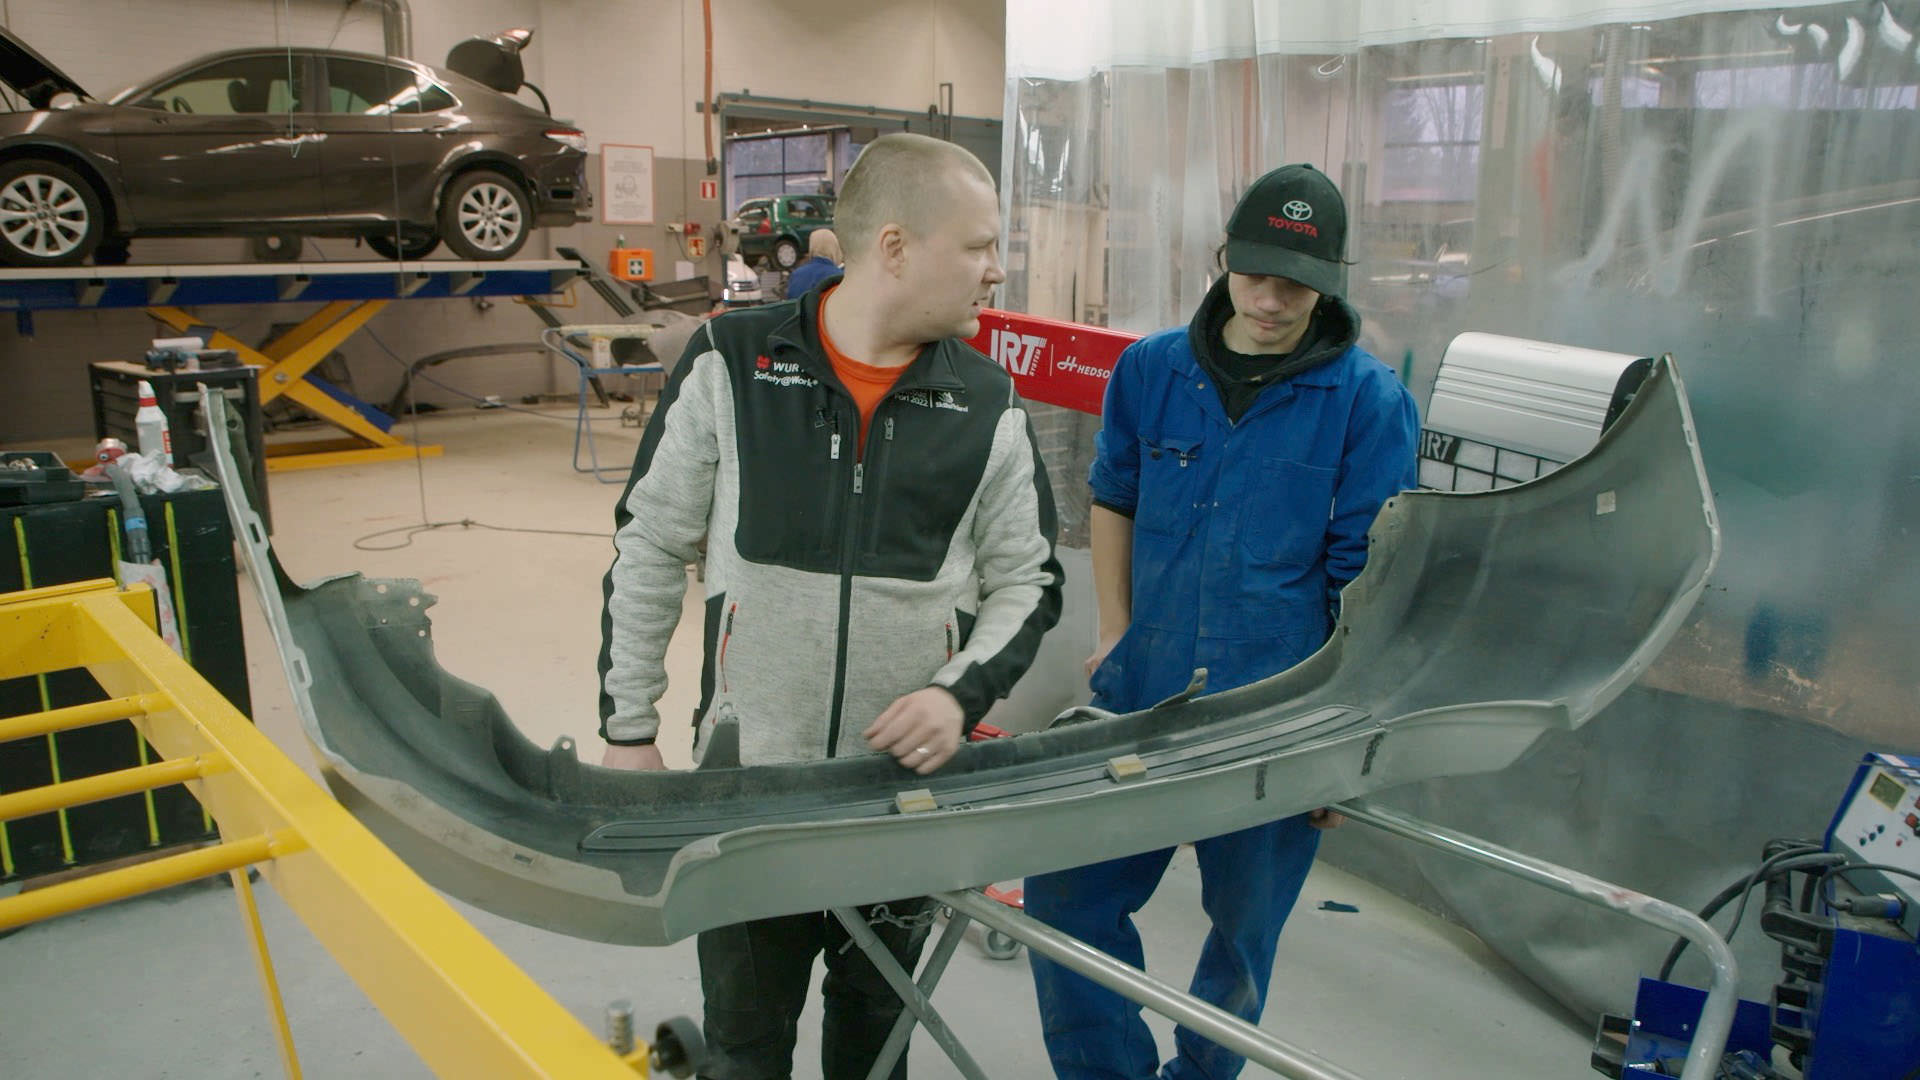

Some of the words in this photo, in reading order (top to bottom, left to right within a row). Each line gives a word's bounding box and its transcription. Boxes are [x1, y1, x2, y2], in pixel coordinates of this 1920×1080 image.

[1266, 215, 1319, 238] TOYOTA
[990, 328, 1046, 376] IRT
[773, 361, 805, 373] WUR
[1077, 364, 1111, 379] HEDSO
[910, 396, 929, 407] 2022
[1420, 430, 1454, 462] IRT
